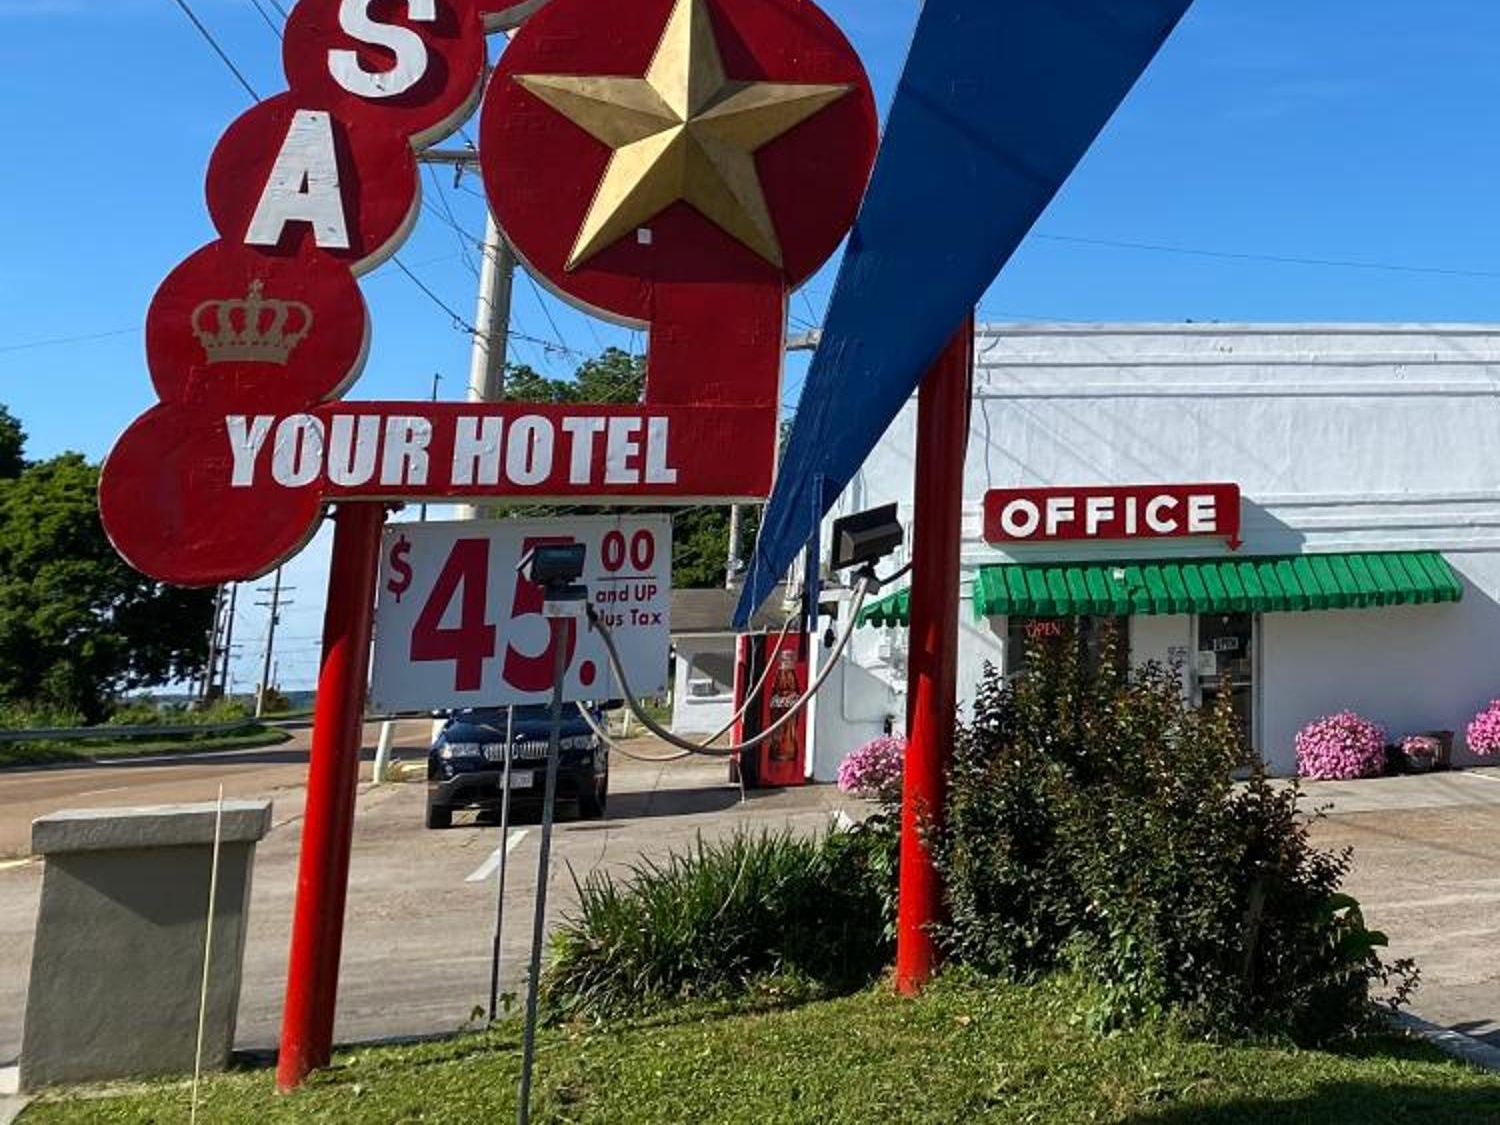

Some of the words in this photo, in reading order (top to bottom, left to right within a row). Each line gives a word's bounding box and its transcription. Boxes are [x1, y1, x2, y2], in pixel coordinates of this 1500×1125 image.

[225, 414, 433, 487] YOUR
[450, 414, 679, 486] HOTEL
[1001, 494, 1217, 538] OFFICE
[596, 584, 629, 603] and
[635, 584, 657, 601] UP
[630, 608, 662, 626] Tax
